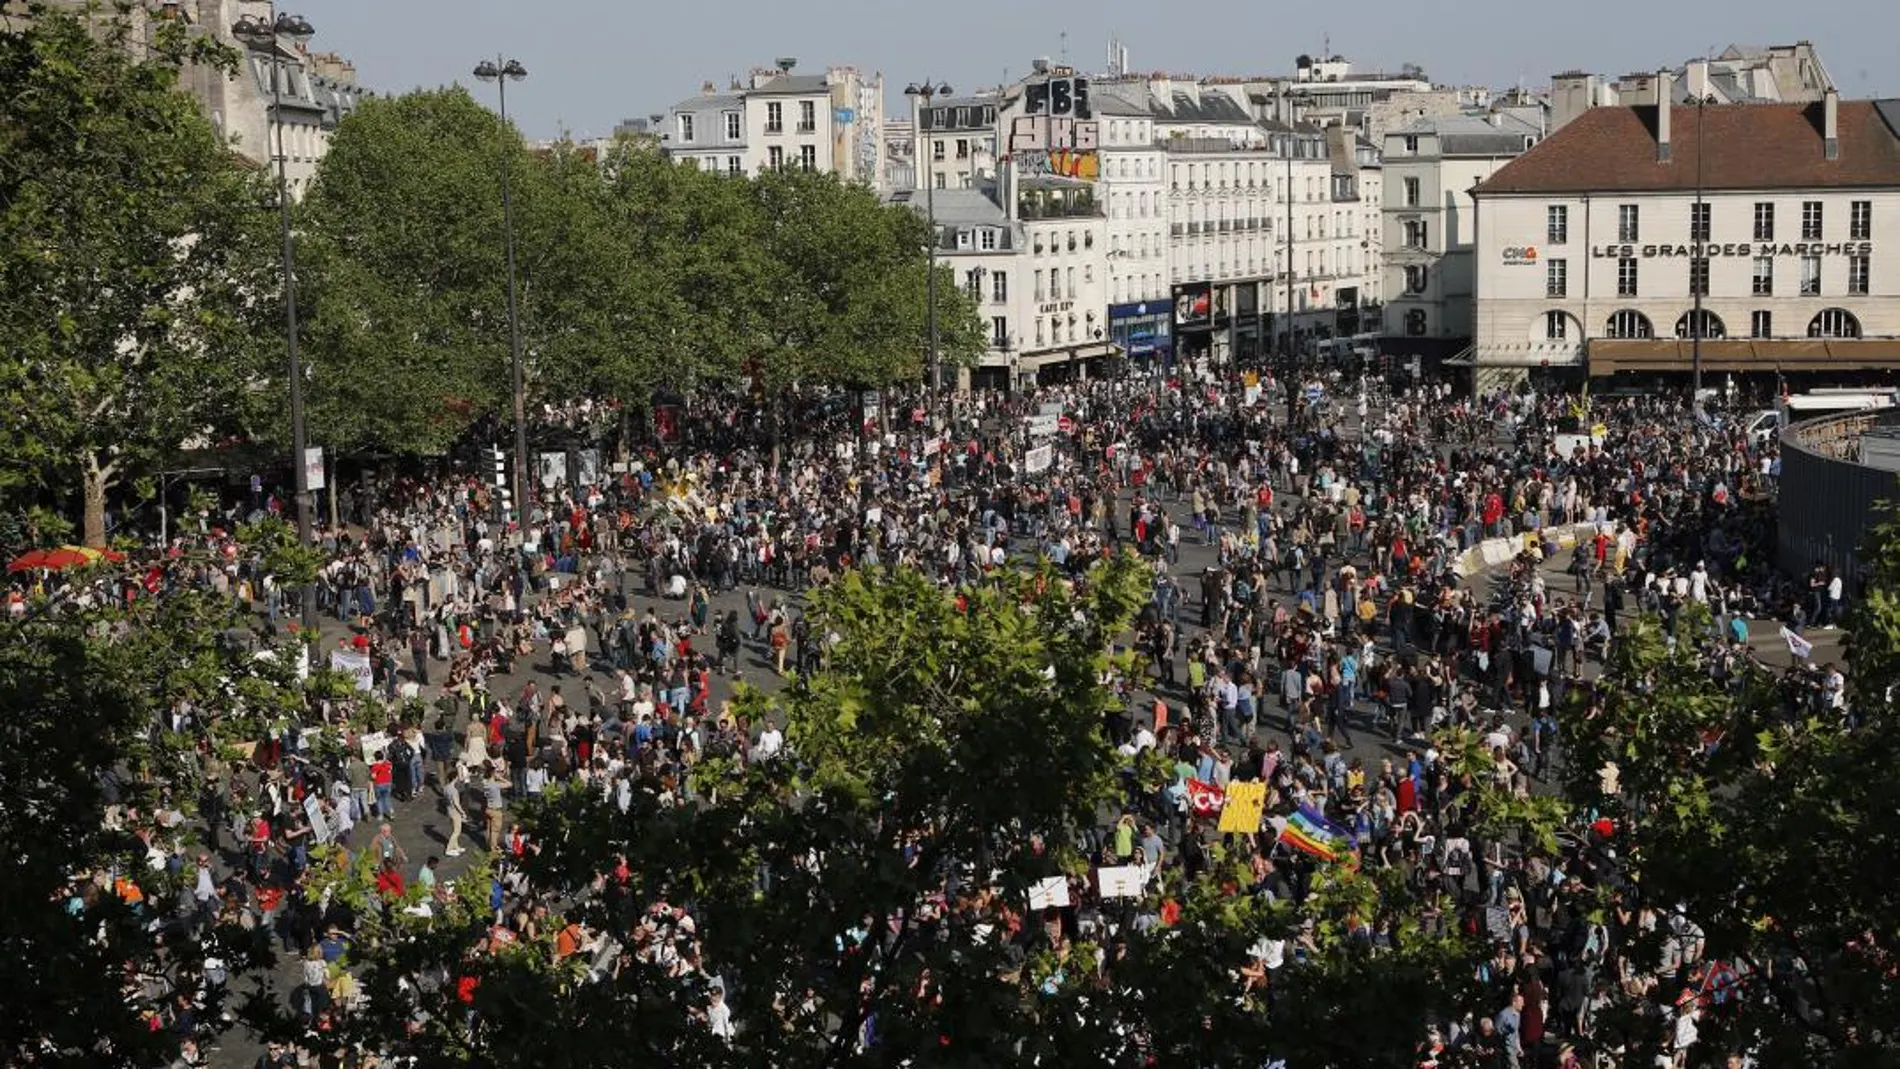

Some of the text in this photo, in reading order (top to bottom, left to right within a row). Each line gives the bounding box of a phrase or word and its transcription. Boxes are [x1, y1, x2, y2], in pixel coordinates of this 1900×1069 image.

[1593, 242, 1873, 258] LES GRANDES MARCHES
